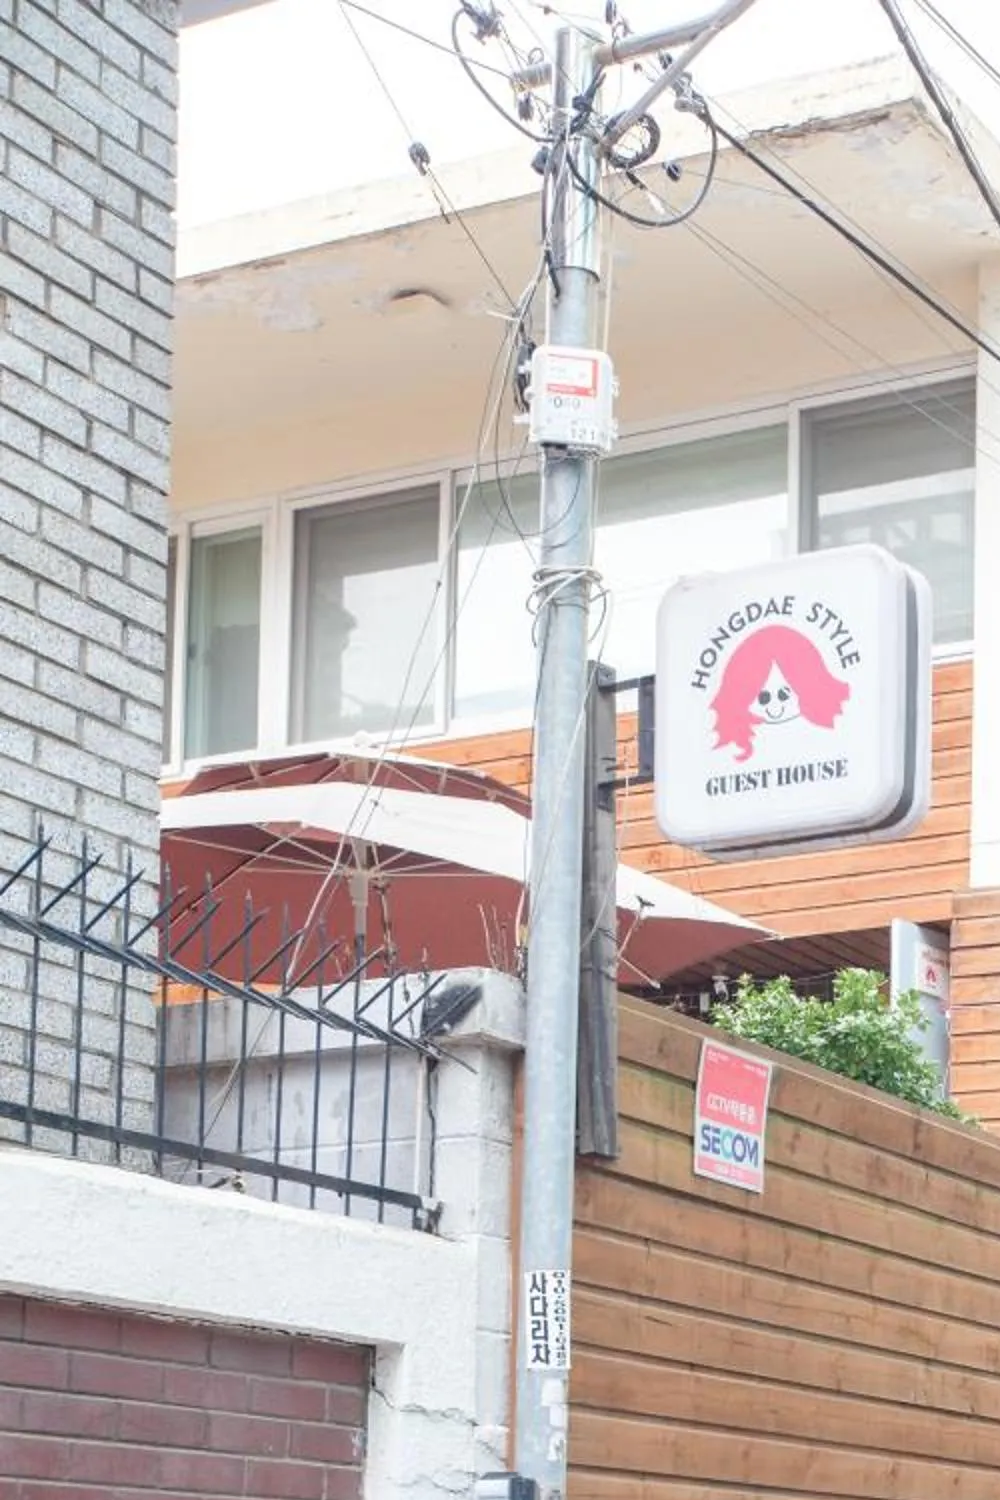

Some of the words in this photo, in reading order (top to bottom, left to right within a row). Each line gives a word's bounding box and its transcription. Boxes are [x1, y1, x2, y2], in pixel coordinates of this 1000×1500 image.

[691, 595, 796, 690] HONGDAE
[806, 602, 861, 669] STYLE
[705, 769, 773, 796] GUEST
[777, 759, 849, 787] HOUSE
[701, 1124, 759, 1168] SECOM
